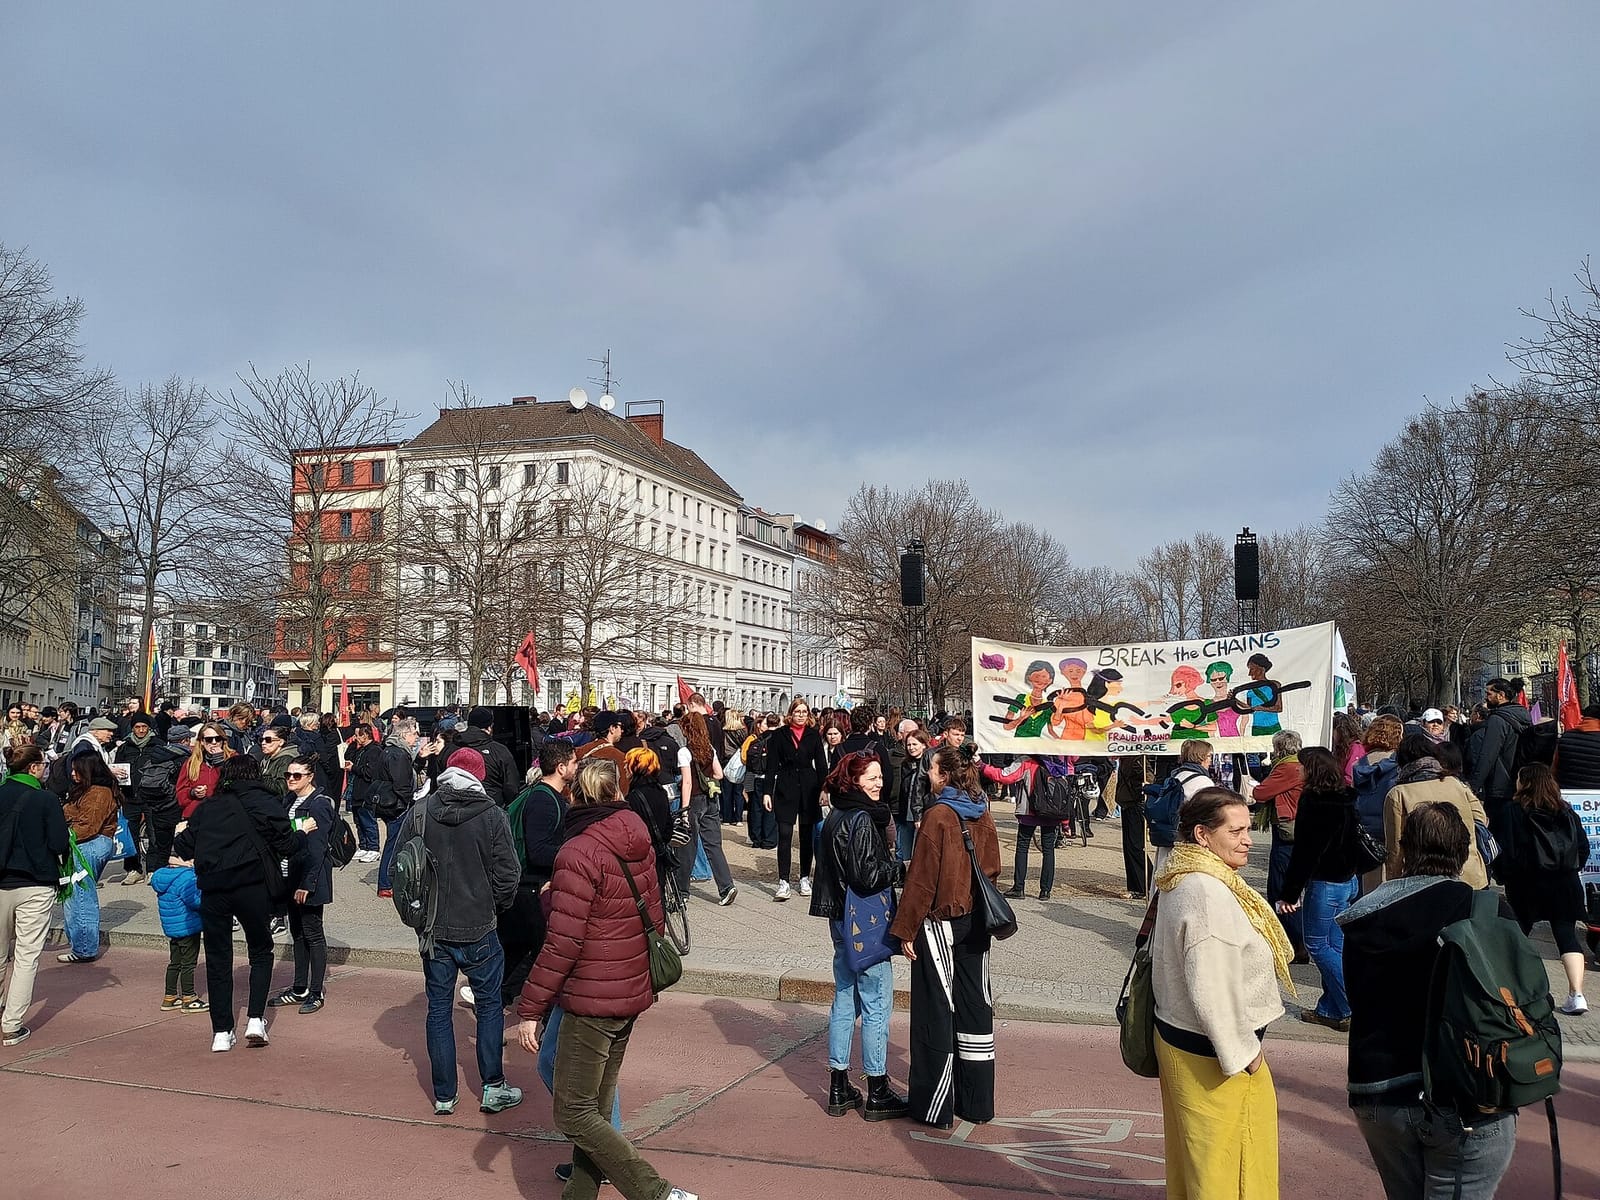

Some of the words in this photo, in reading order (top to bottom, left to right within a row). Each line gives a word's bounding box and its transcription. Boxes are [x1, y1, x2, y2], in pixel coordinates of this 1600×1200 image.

[1097, 647, 1166, 667] BREAK
[1173, 646, 1199, 662] the
[1202, 632, 1280, 658] CHAINS
[1107, 742, 1167, 752] COURAGE
